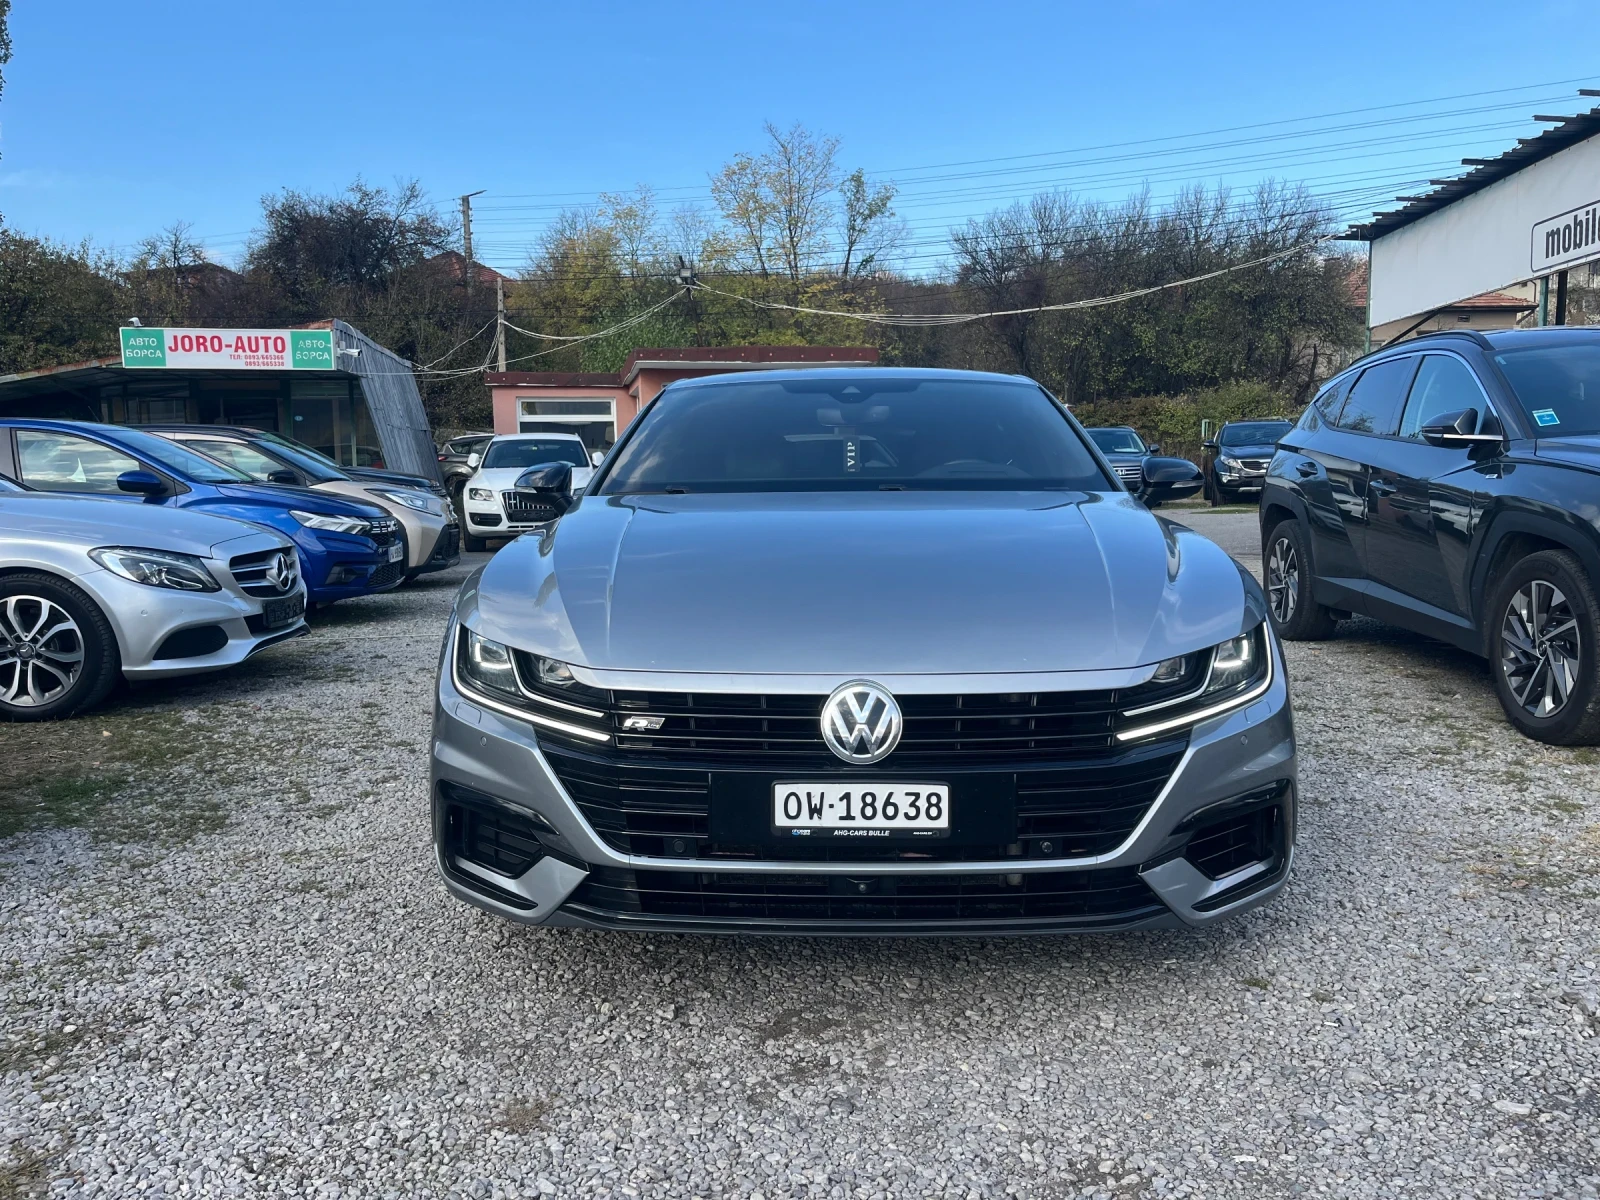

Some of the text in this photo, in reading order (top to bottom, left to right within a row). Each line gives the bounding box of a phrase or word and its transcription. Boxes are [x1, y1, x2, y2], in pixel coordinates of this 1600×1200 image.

[129, 338, 157, 346] АВТО
[168, 335, 286, 353] JORO-AUTO
[298, 340, 325, 348] АВТО
[126, 350, 163, 358] БОРСА
[847, 442, 855, 467] VIP
